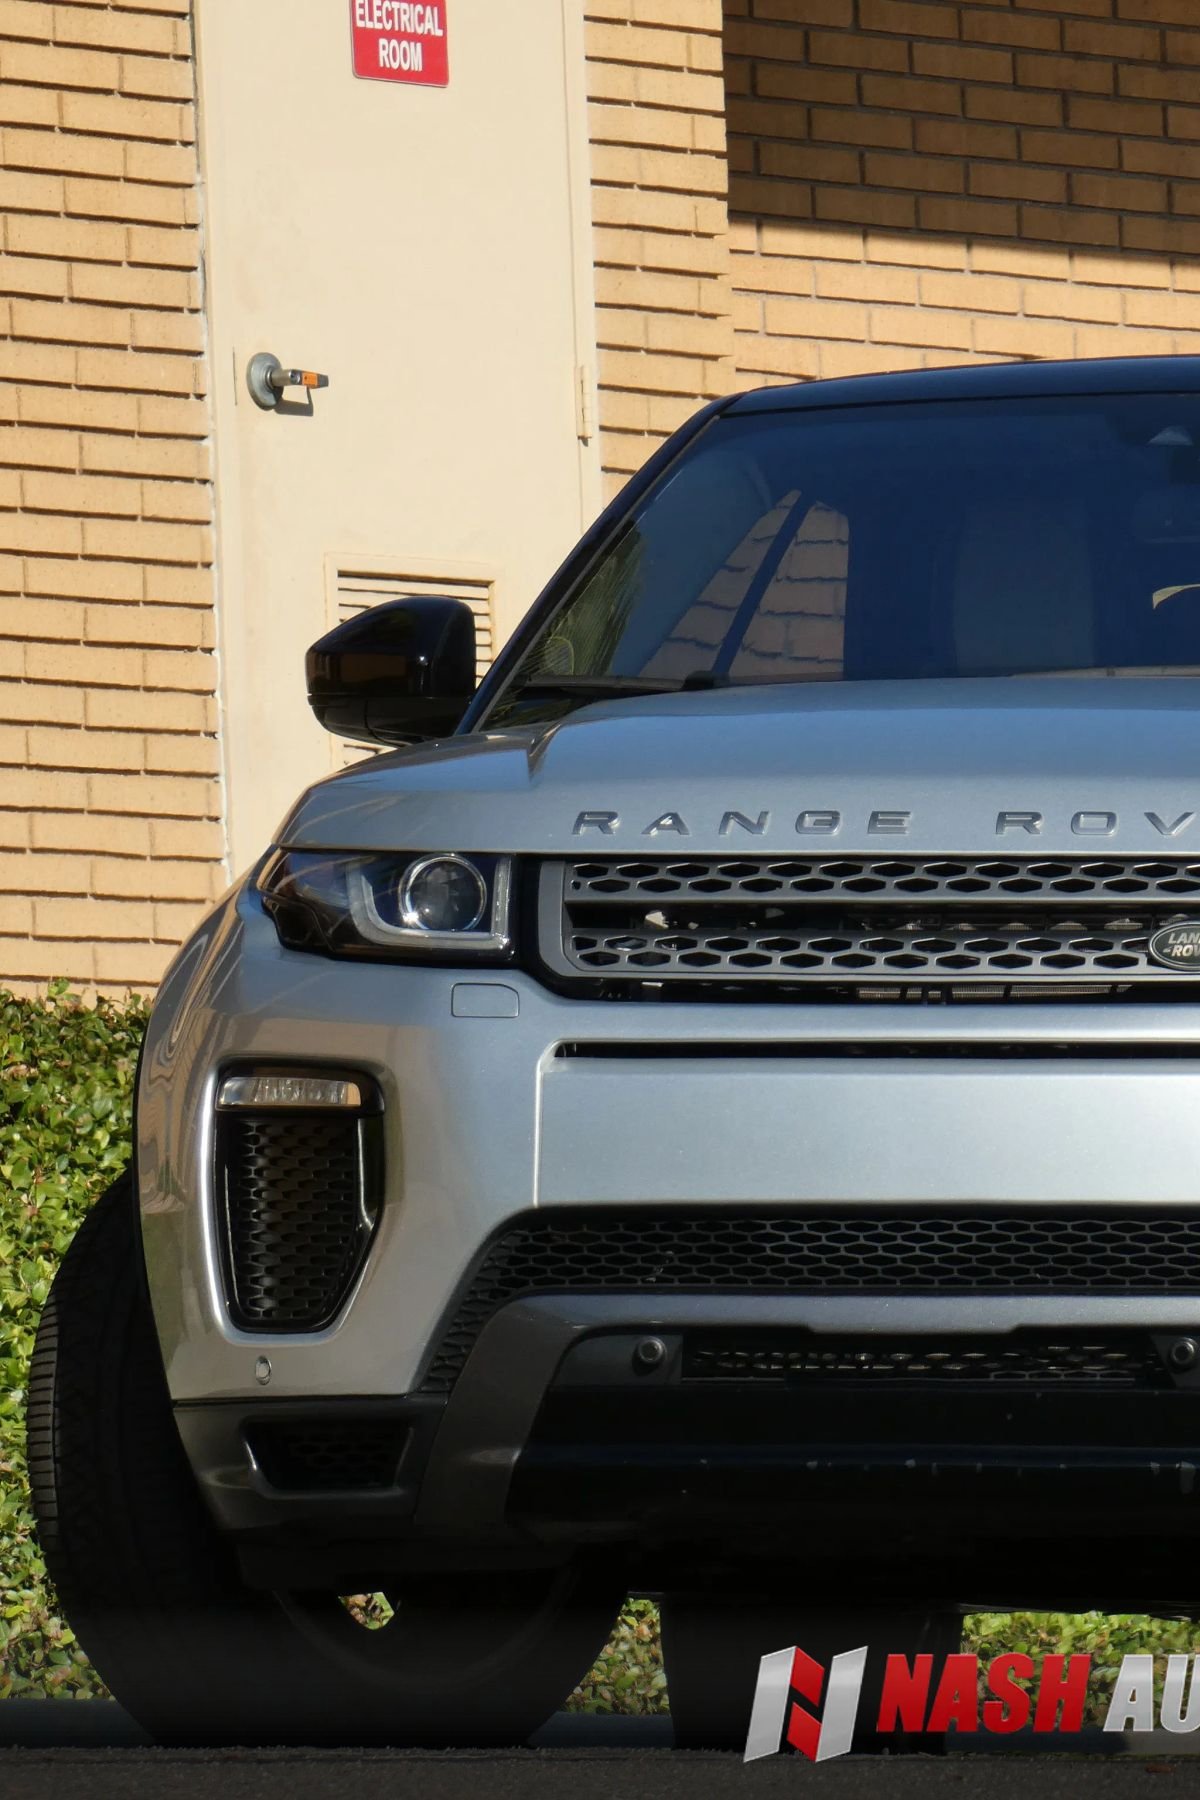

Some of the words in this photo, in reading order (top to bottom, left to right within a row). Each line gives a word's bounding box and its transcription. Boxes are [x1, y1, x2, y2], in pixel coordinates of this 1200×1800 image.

[355, 0, 443, 36] ELECTRICAL
[378, 38, 423, 71] ROOM
[571, 810, 913, 836] RANGE
